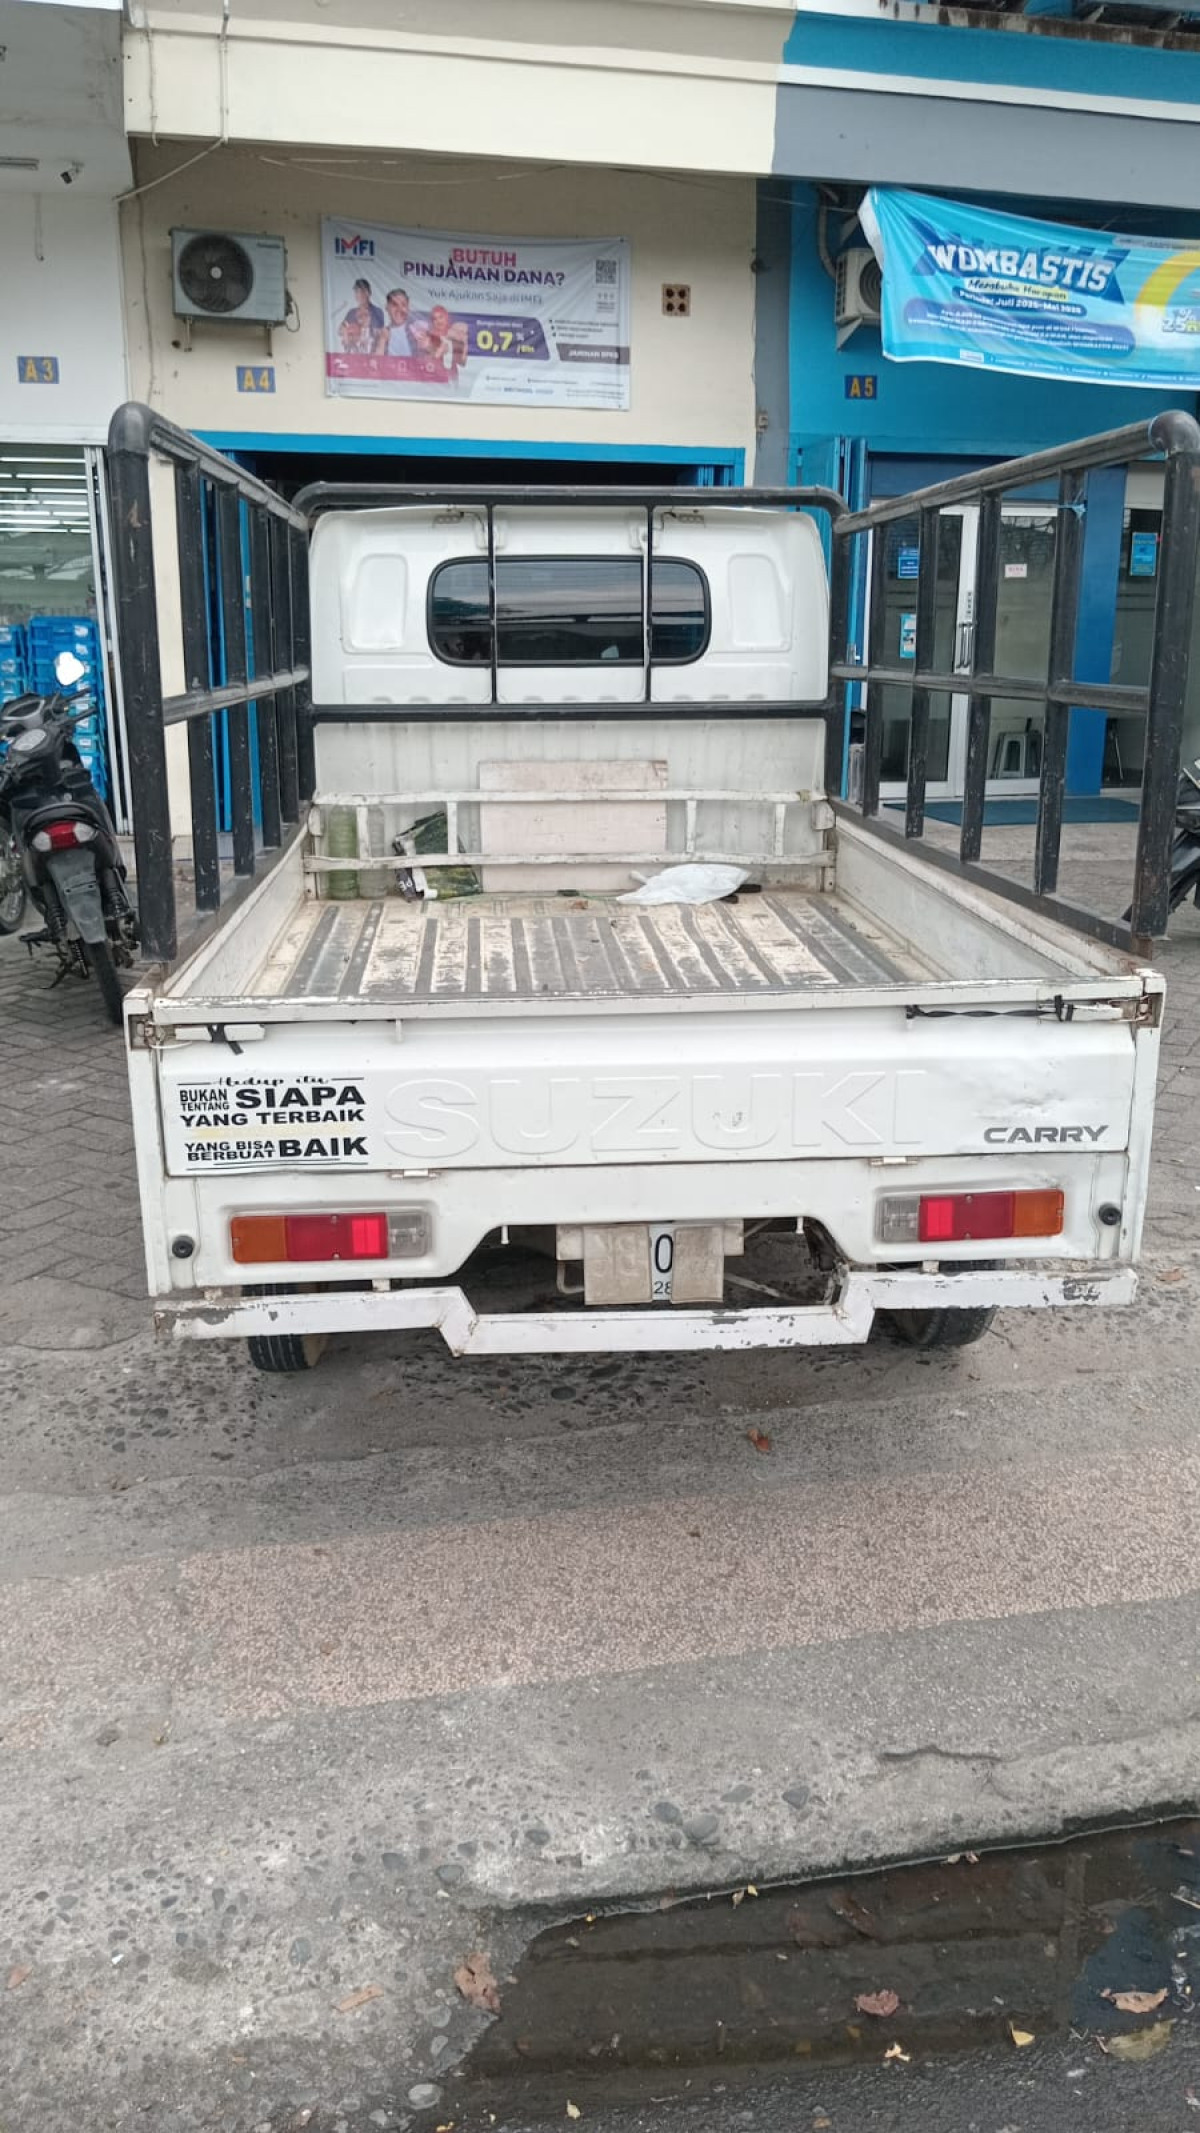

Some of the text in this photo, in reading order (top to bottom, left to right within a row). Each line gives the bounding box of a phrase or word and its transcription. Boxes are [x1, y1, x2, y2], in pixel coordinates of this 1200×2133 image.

[452, 248, 517, 267] BUTUH
[403, 261, 565, 286] PINJAMAN DANA?
[927, 244, 1116, 291] WOMBASTIS
[477, 330, 513, 353] 0,7
[179, 1089, 228, 1102] BUKAN
[235, 1085, 366, 1109] SIAPA
[181, 1101, 230, 1112] TENTANG
[384, 1071, 927, 1158] SUZUKI
[180, 1109, 365, 1127] YANG TERBAIK
[983, 1125, 1109, 1143] CARRY
[185, 1140, 275, 1151] YANG BISA
[278, 1137, 369, 1157] BAIK
[187, 1150, 275, 1161] BERBUAT
